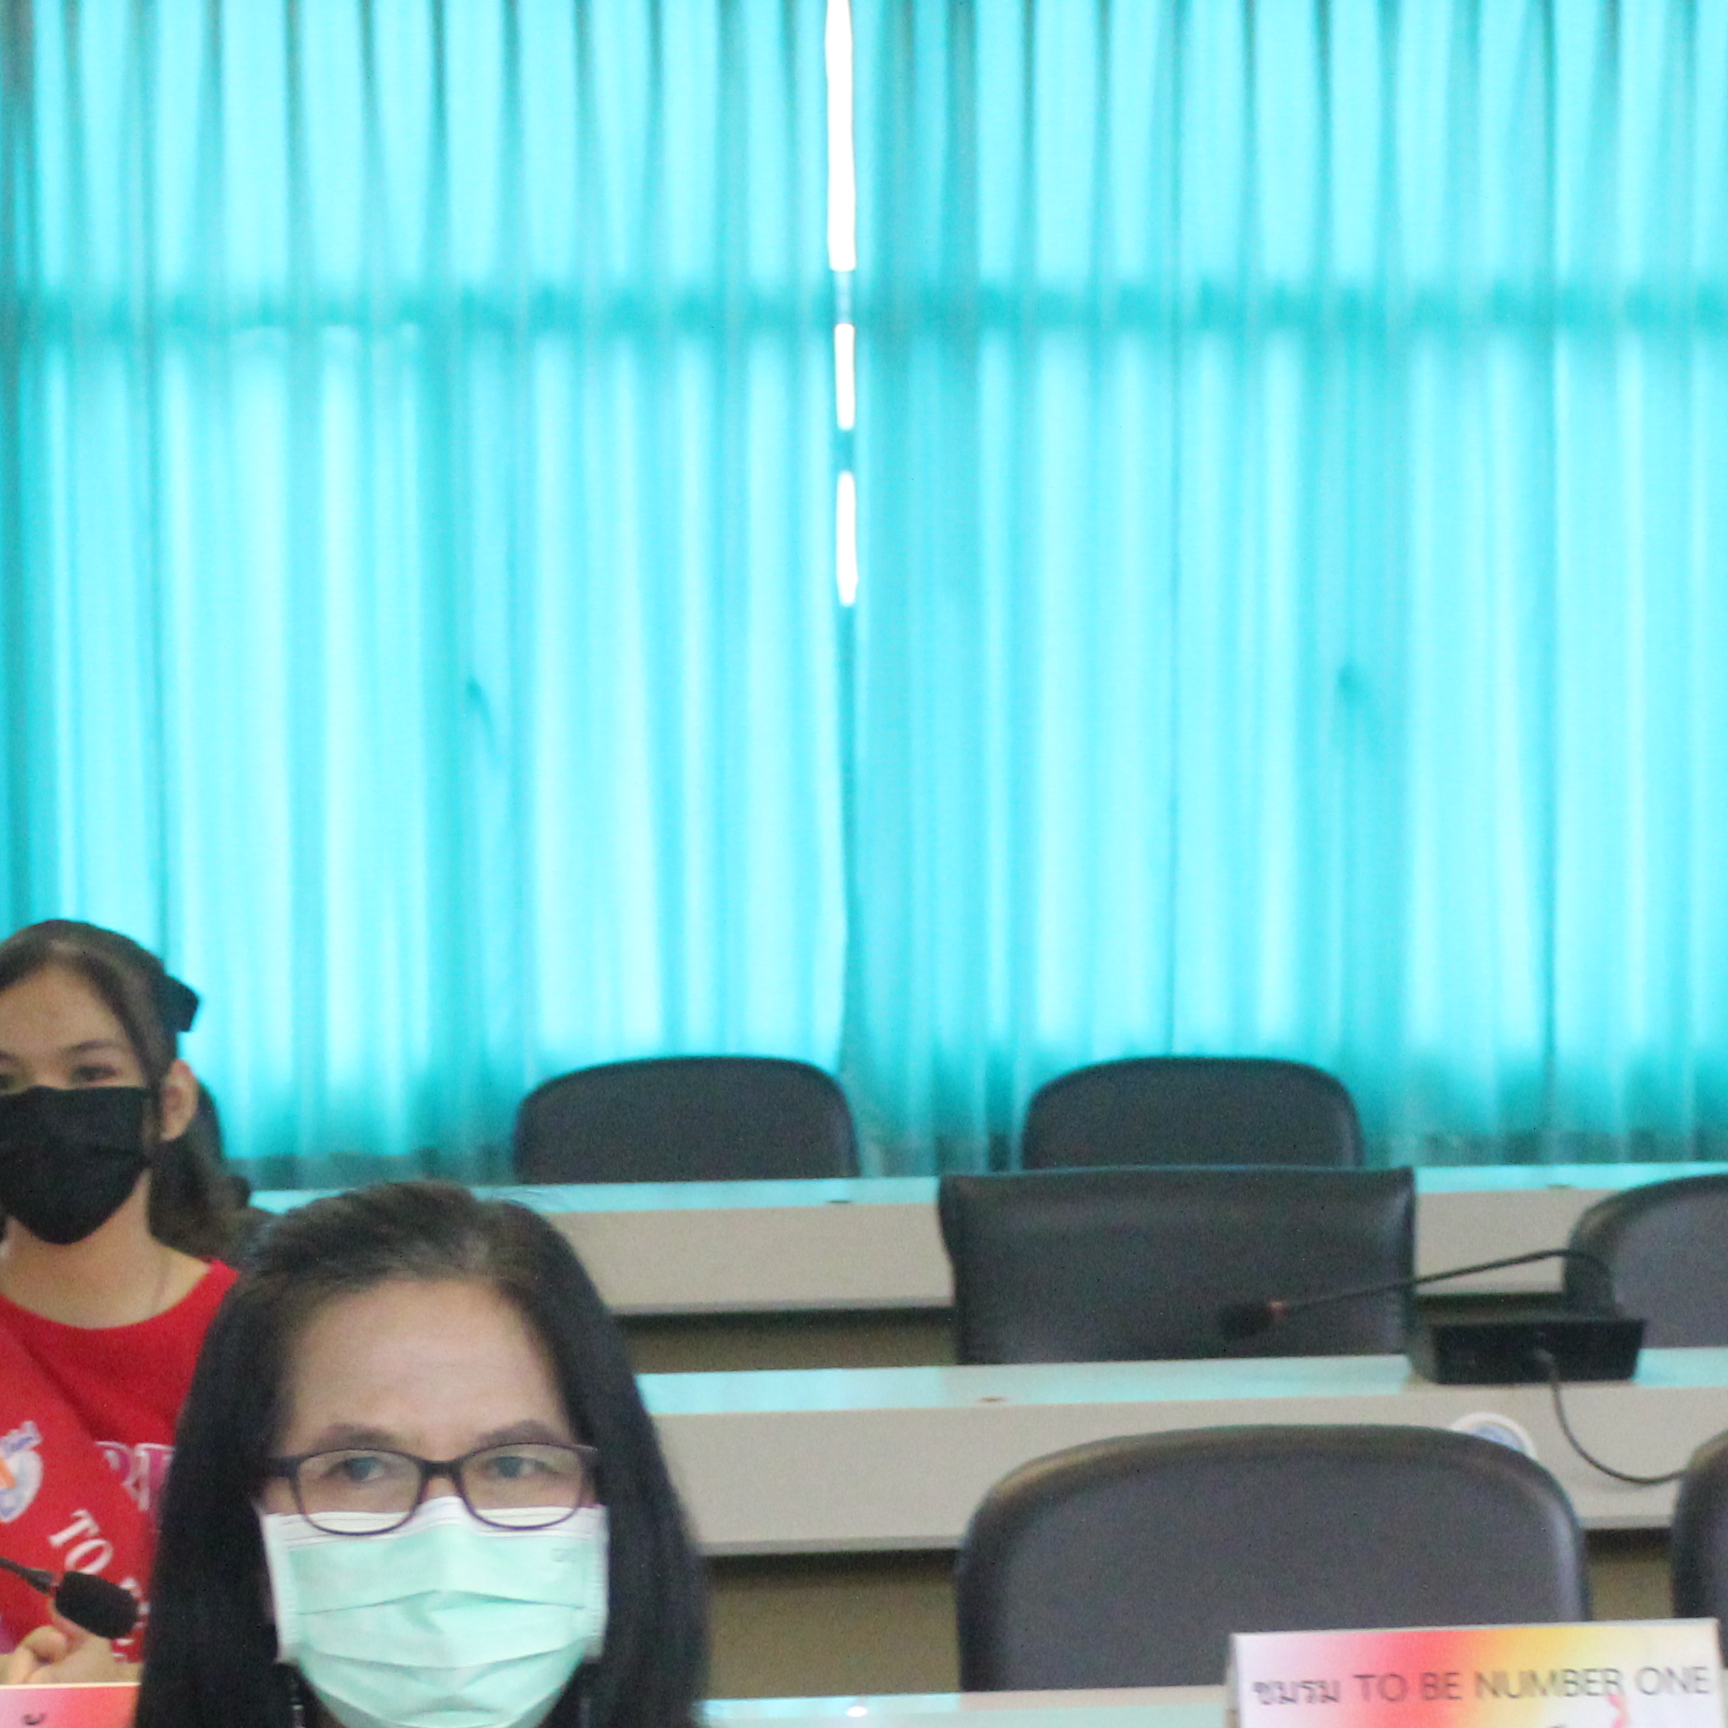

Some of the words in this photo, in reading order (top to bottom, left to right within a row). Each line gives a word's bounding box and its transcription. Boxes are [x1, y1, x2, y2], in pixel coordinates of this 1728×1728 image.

[1252, 1676, 1341, 1705] ชมรม
[1354, 1672, 1405, 1703] TO
[1422, 1671, 1461, 1702] BE
[1475, 1667, 1623, 1700] NUMBER
[1635, 1665, 1711, 1697] ONE
